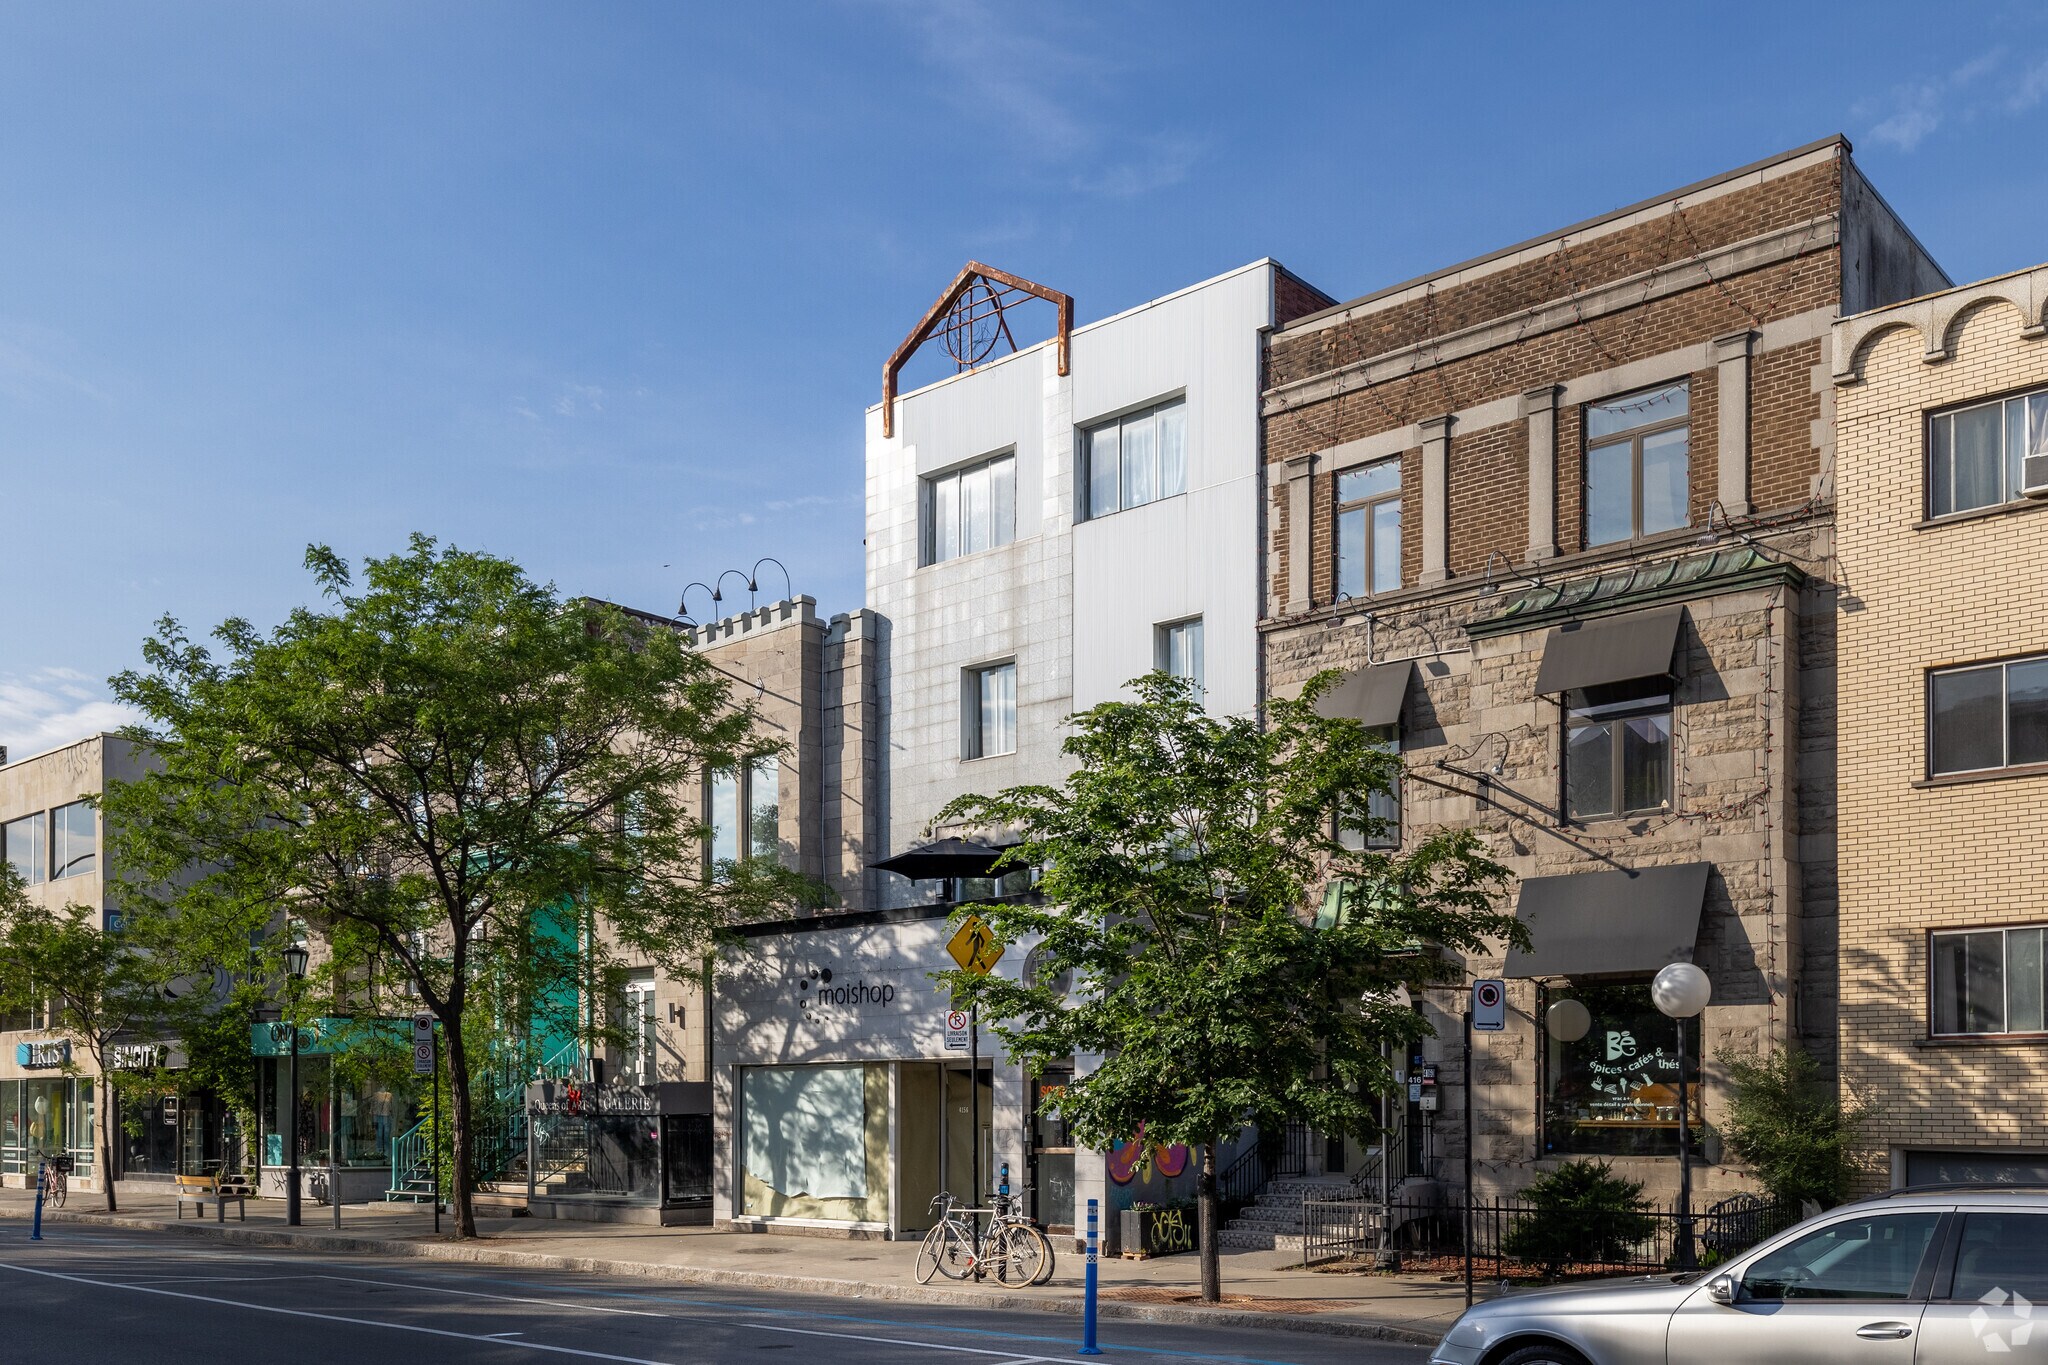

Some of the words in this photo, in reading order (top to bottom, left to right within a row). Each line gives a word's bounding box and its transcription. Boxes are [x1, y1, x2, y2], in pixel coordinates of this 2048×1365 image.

[818, 980, 894, 1008] moishop
[1589, 1060, 1622, 1075] épices
[1628, 1052, 1654, 1072] cafés
[1655, 1047, 1664, 1057] &
[603, 1097, 651, 1112] GALERIE
